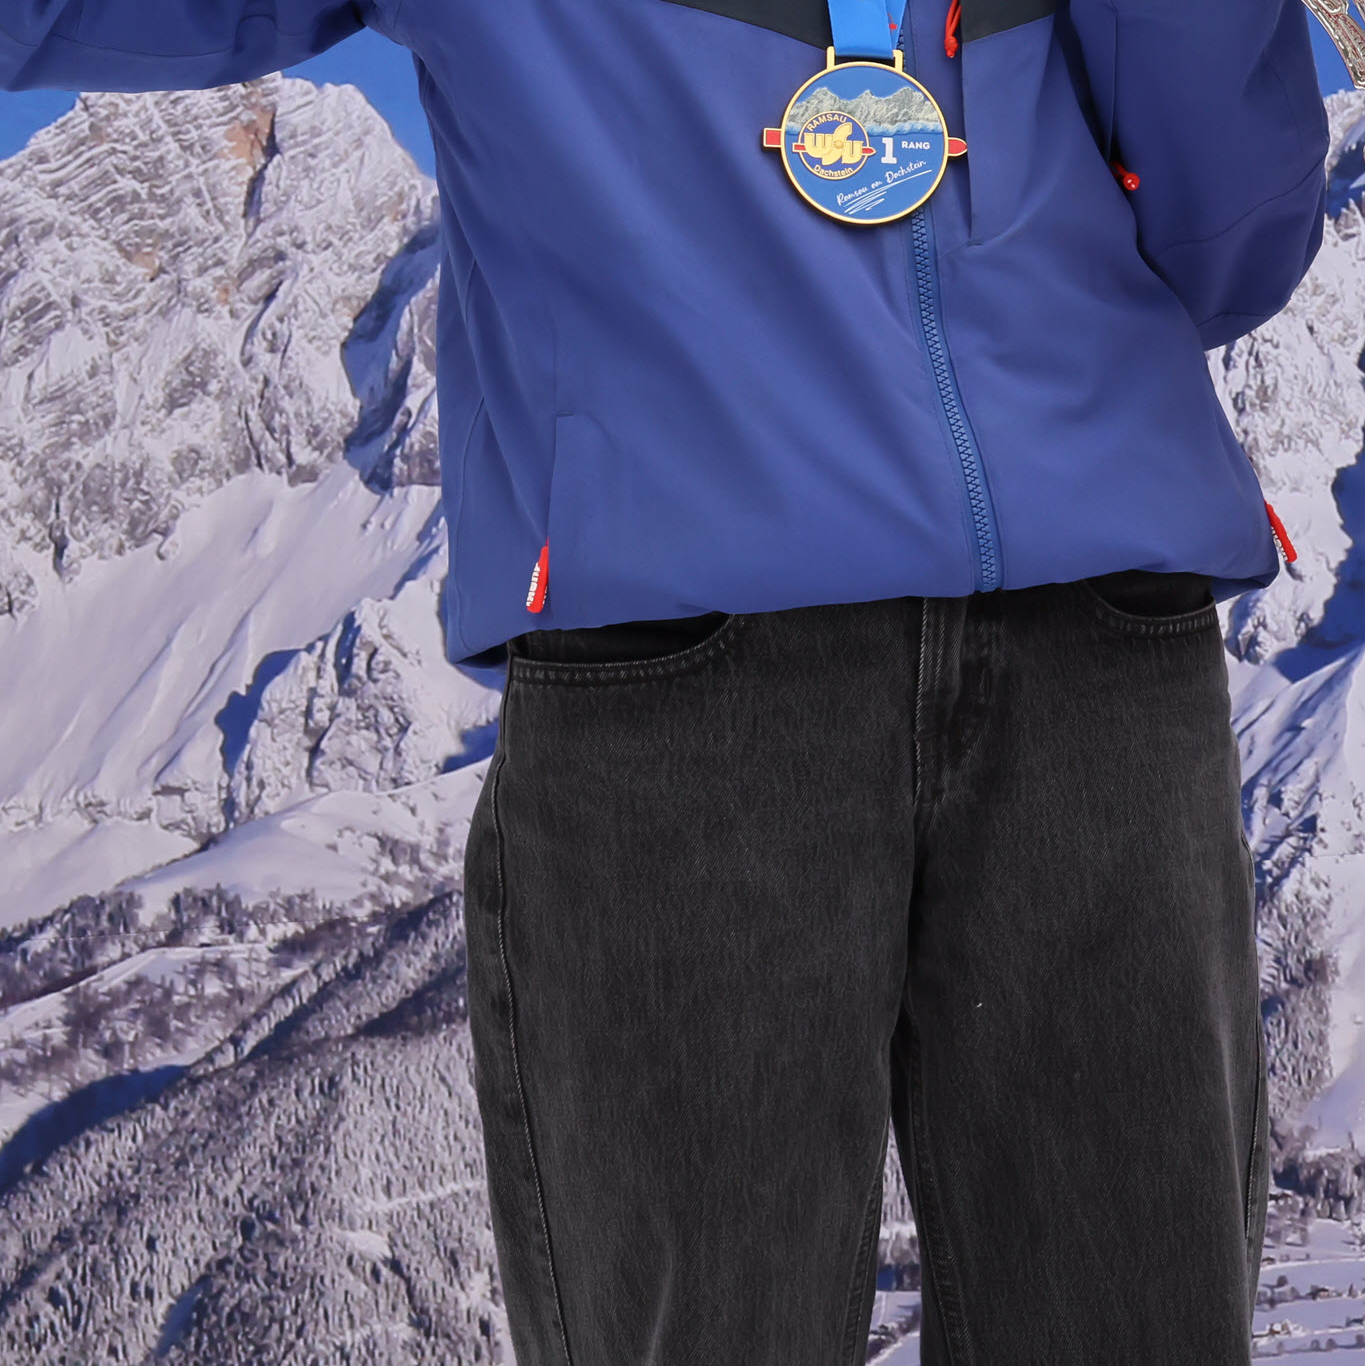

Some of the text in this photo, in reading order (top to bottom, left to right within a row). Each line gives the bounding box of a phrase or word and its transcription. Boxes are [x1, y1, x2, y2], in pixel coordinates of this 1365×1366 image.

[807, 113, 847, 132] RAMSAU
[881, 137, 930, 164] 1 RANG
[813, 165, 853, 178] Dachstein
